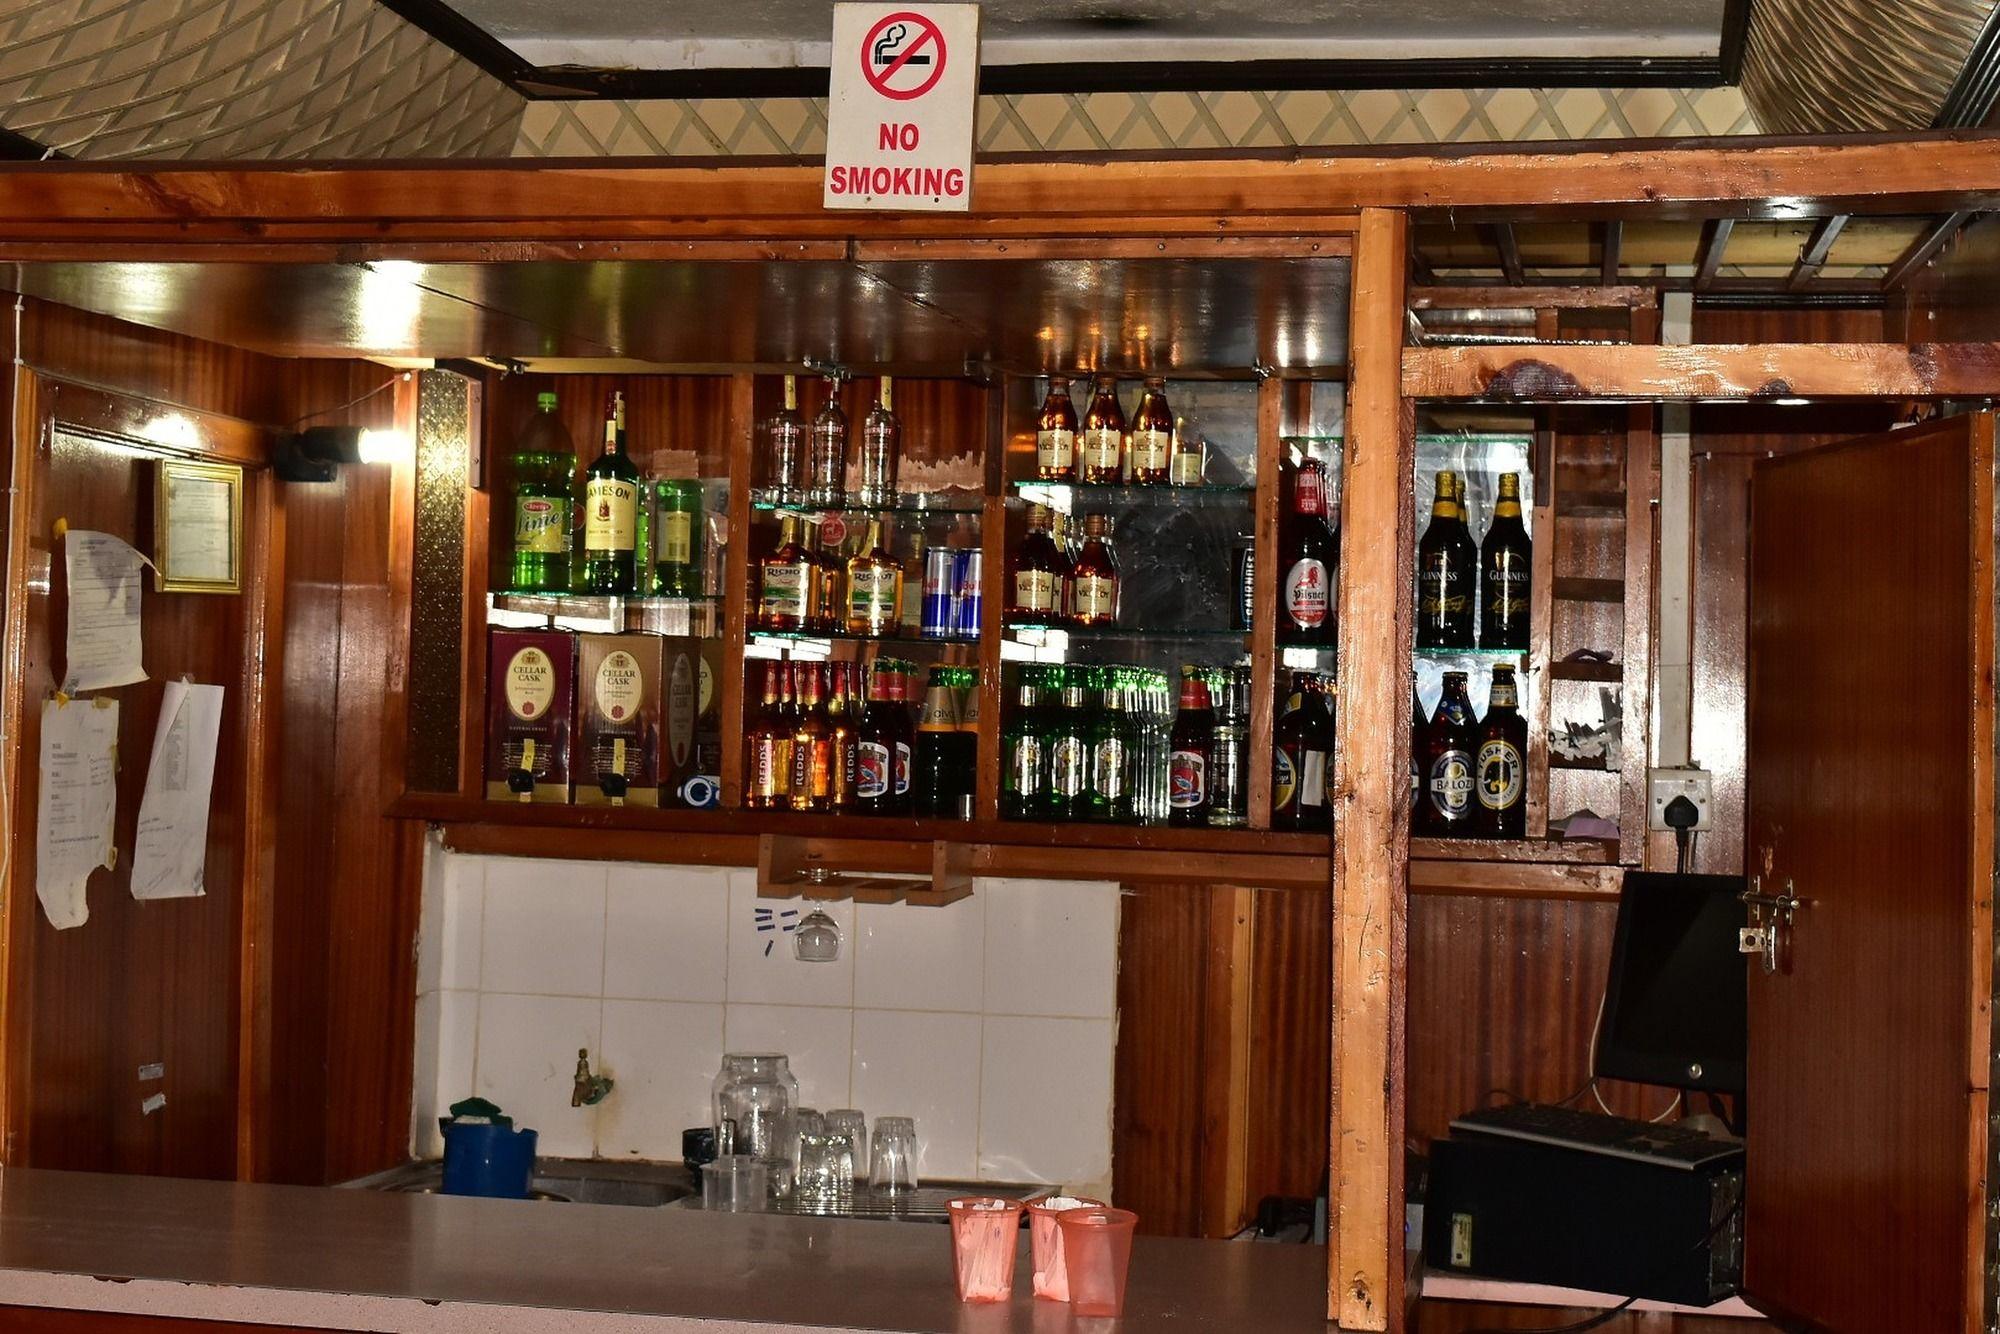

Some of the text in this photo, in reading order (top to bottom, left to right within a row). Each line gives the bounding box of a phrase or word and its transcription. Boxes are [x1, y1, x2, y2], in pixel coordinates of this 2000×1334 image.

[880, 123, 920, 151] NO
[830, 166, 964, 196] SMOKING
[770, 427, 799, 435] SMIROFF
[815, 425, 843, 434] SMIROFF
[864, 427, 891, 435] SMIROFF
[589, 485, 631, 500] AMESON
[767, 567, 803, 576] RICHO
[1422, 570, 1458, 582] UINNSS
[1489, 569, 1529, 582] GUNNESS
[1018, 583, 1050, 593] VICEOY
[1293, 589, 1325, 600] Pilsner
[513, 666, 547, 674] CELLAR
[602, 669, 636, 677] CELLAR
[607, 677, 630, 685] CASK
[1480, 746, 1519, 771] TUSKER
[1436, 780, 1474, 790] BALOZI
